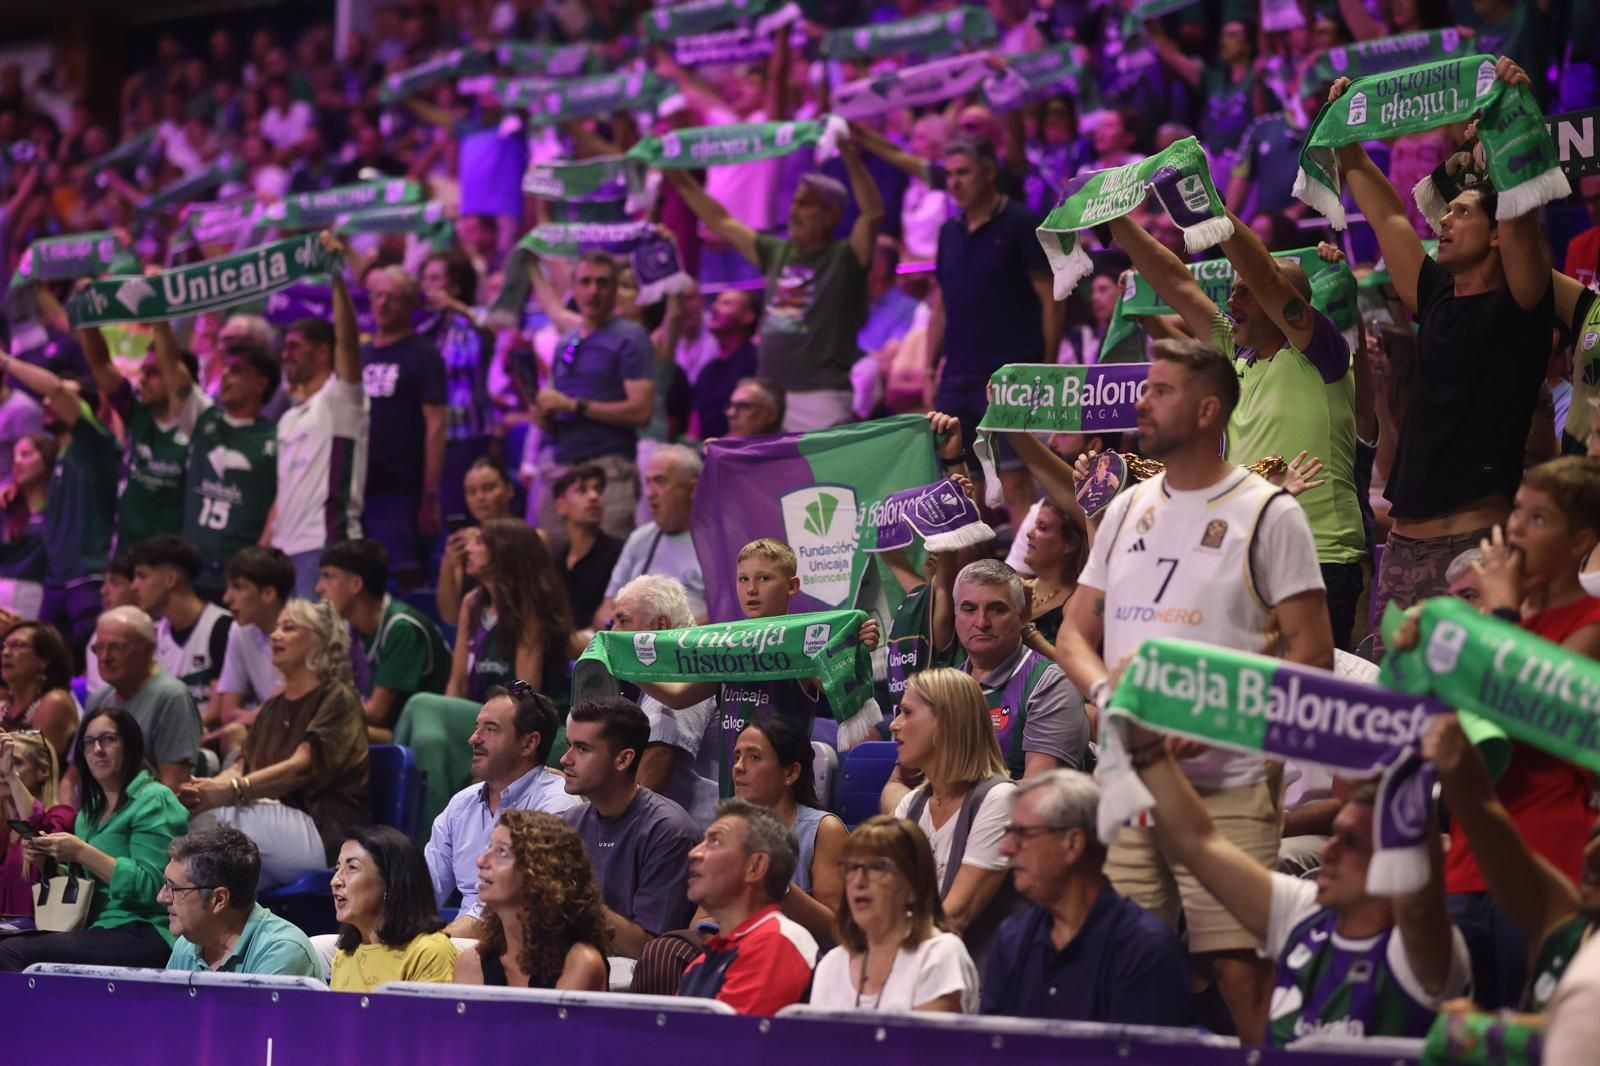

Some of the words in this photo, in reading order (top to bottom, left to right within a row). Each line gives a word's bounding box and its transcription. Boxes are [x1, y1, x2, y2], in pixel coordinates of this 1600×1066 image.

[1381, 87, 1458, 127] Unicaja
[163, 250, 288, 305] Unicaja
[991, 375, 1055, 416] nicaja
[1061, 374, 1149, 407] Balonc
[198, 496, 232, 530] 15
[809, 558, 849, 573] Unicaja
[1157, 558, 1179, 603] 7
[678, 624, 787, 654] Unicaja
[675, 647, 791, 674] histórico
[724, 688, 769, 707] Unicaja
[1131, 647, 1229, 715] nicaja
